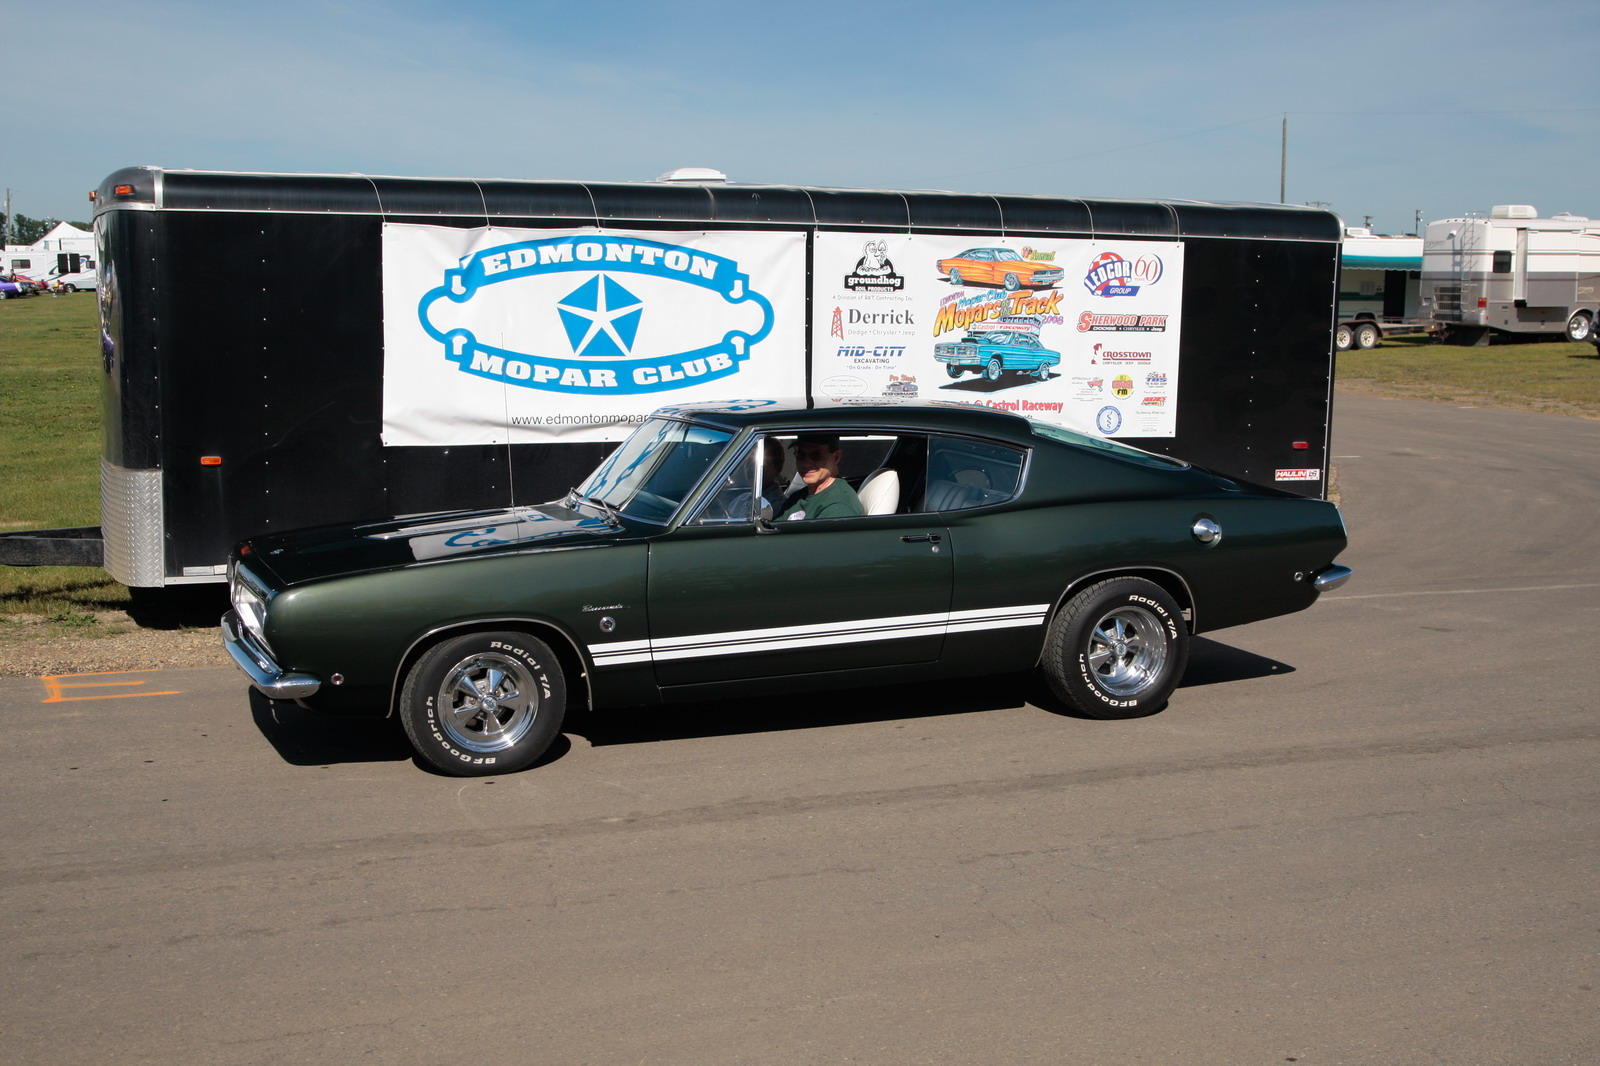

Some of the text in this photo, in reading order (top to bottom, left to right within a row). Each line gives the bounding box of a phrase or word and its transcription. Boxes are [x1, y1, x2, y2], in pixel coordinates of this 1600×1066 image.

[480, 242, 719, 281] EDMONTON
[1084, 261, 1131, 291] LEDCOR
[847, 276, 901, 286] groundhog
[986, 289, 1007, 300] Club
[848, 308, 914, 324] Derrick
[933, 302, 1000, 337] Mopars
[1007, 289, 1064, 315] Track
[1042, 315, 1064, 325] 2008
[1078, 312, 1167, 331] SHERWOOD PARK
[837, 346, 906, 357] MID-CITY
[470, 350, 734, 388] MOPAR CLUB
[1022, 400, 1064, 413] Raceway
[1129, 594, 1178, 640] Radial T/A
[490, 641, 551, 699] Radial T/A
[1079, 654, 1138, 708] BFGoodrich
[426, 696, 496, 764] BFGoodrich
